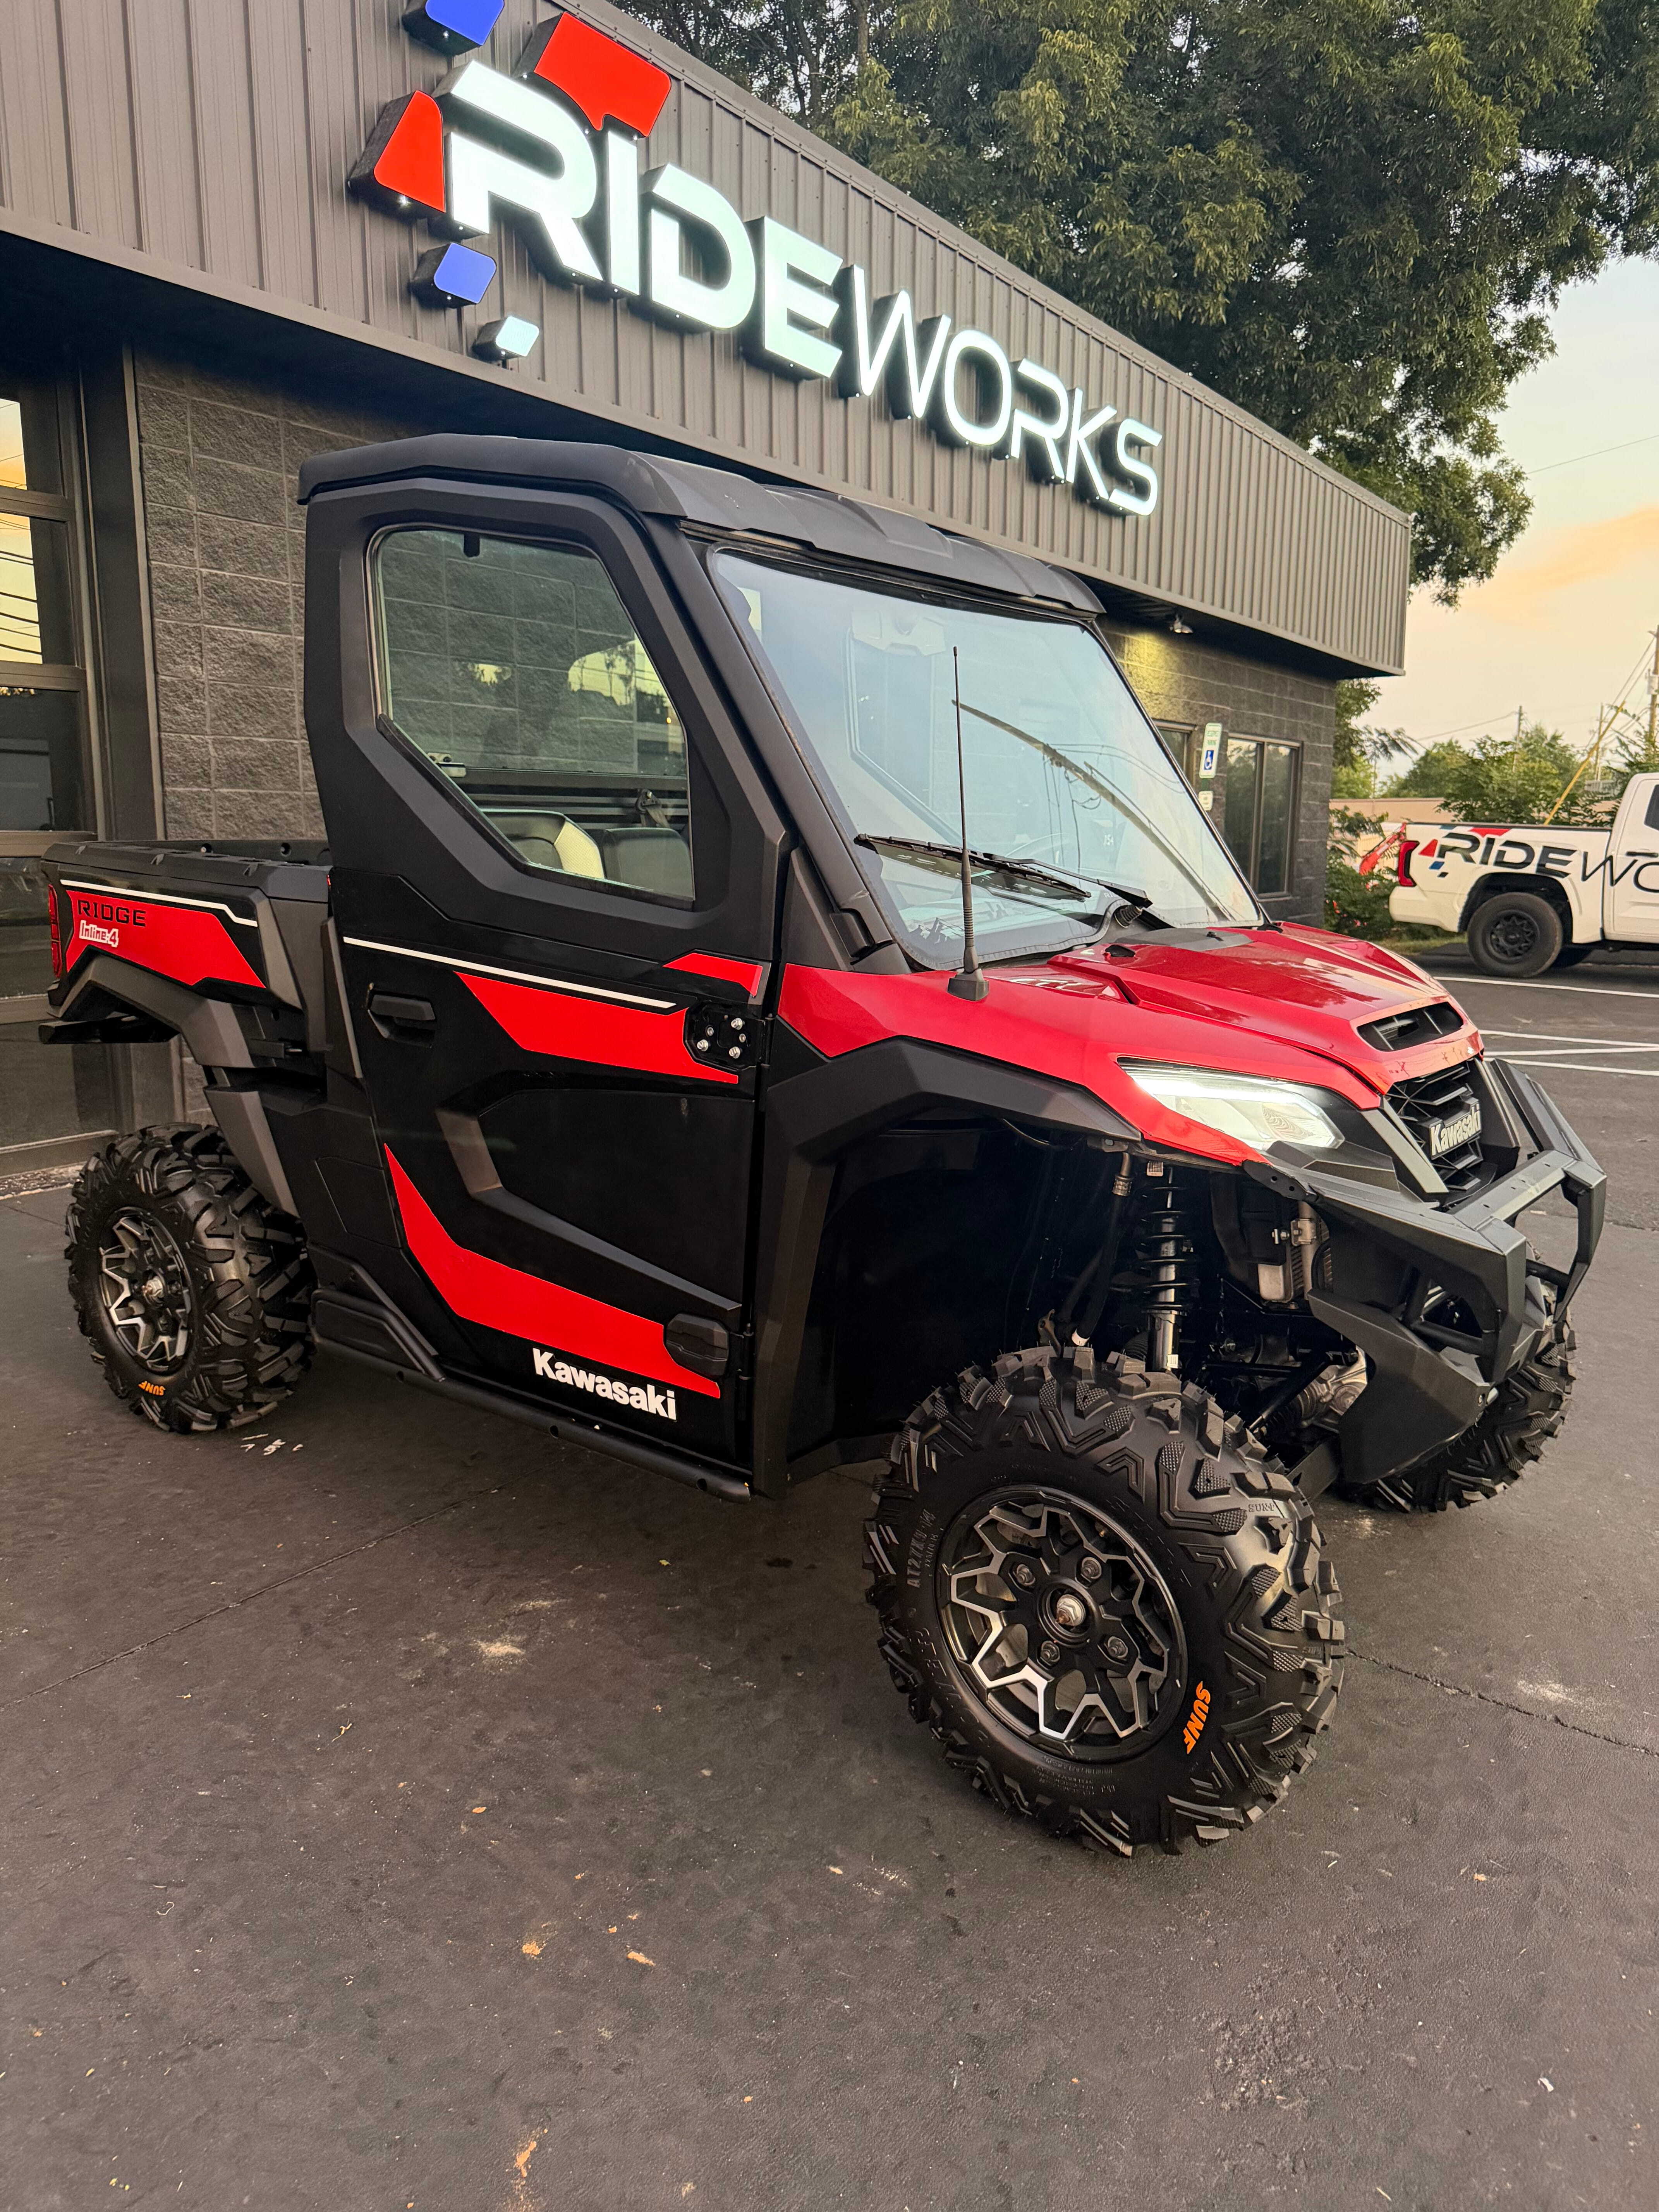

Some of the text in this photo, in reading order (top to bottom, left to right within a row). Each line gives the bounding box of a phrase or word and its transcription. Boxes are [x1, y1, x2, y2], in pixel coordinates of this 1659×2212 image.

[450, 61, 1162, 517] RIDEWORKS
[77, 899, 146, 927] RIDGE
[1431, 1104, 1481, 1156] Kawasaki
[138, 1381, 166, 1396] SUNF
[533, 1348, 676, 1420] Kawasaki
[1183, 1681, 1211, 1754] SUNF
